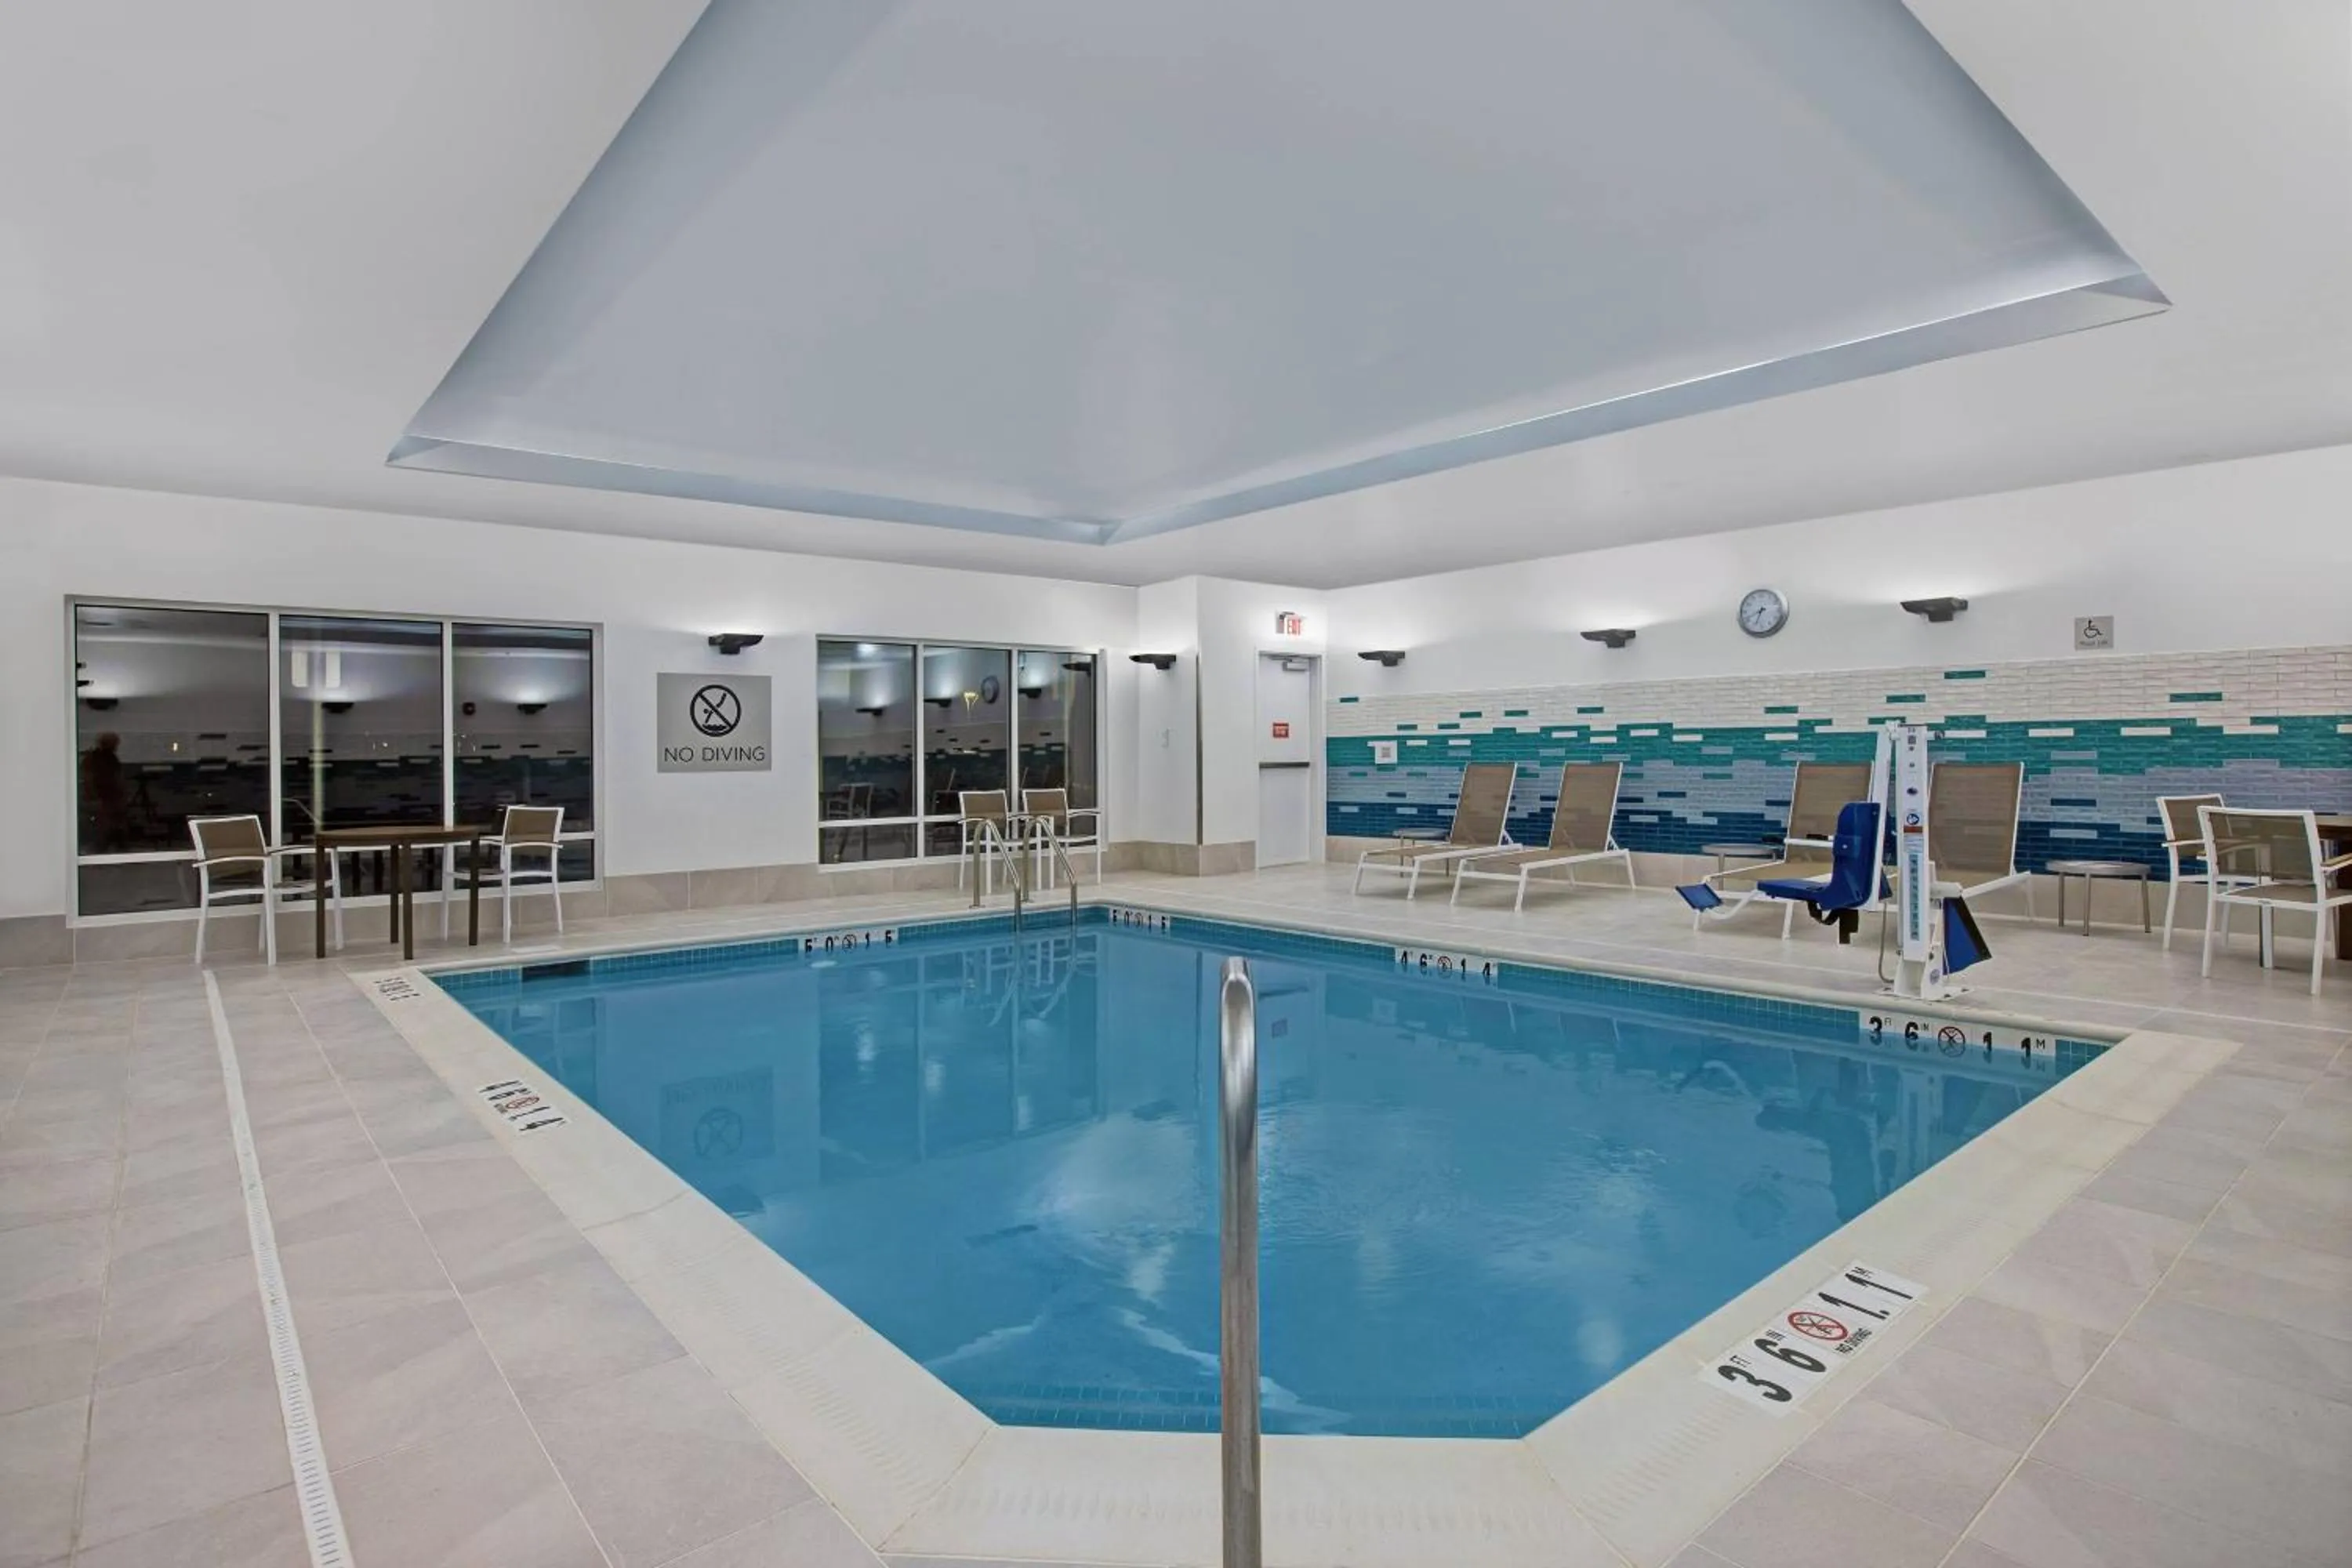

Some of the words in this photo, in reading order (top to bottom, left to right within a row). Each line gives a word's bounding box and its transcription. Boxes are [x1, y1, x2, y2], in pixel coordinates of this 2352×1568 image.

[664, 746, 694, 763] NO
[702, 746, 765, 762] DIVING
[1753, 1338, 1828, 1374] 6
[1717, 1364, 1793, 1403] 3
